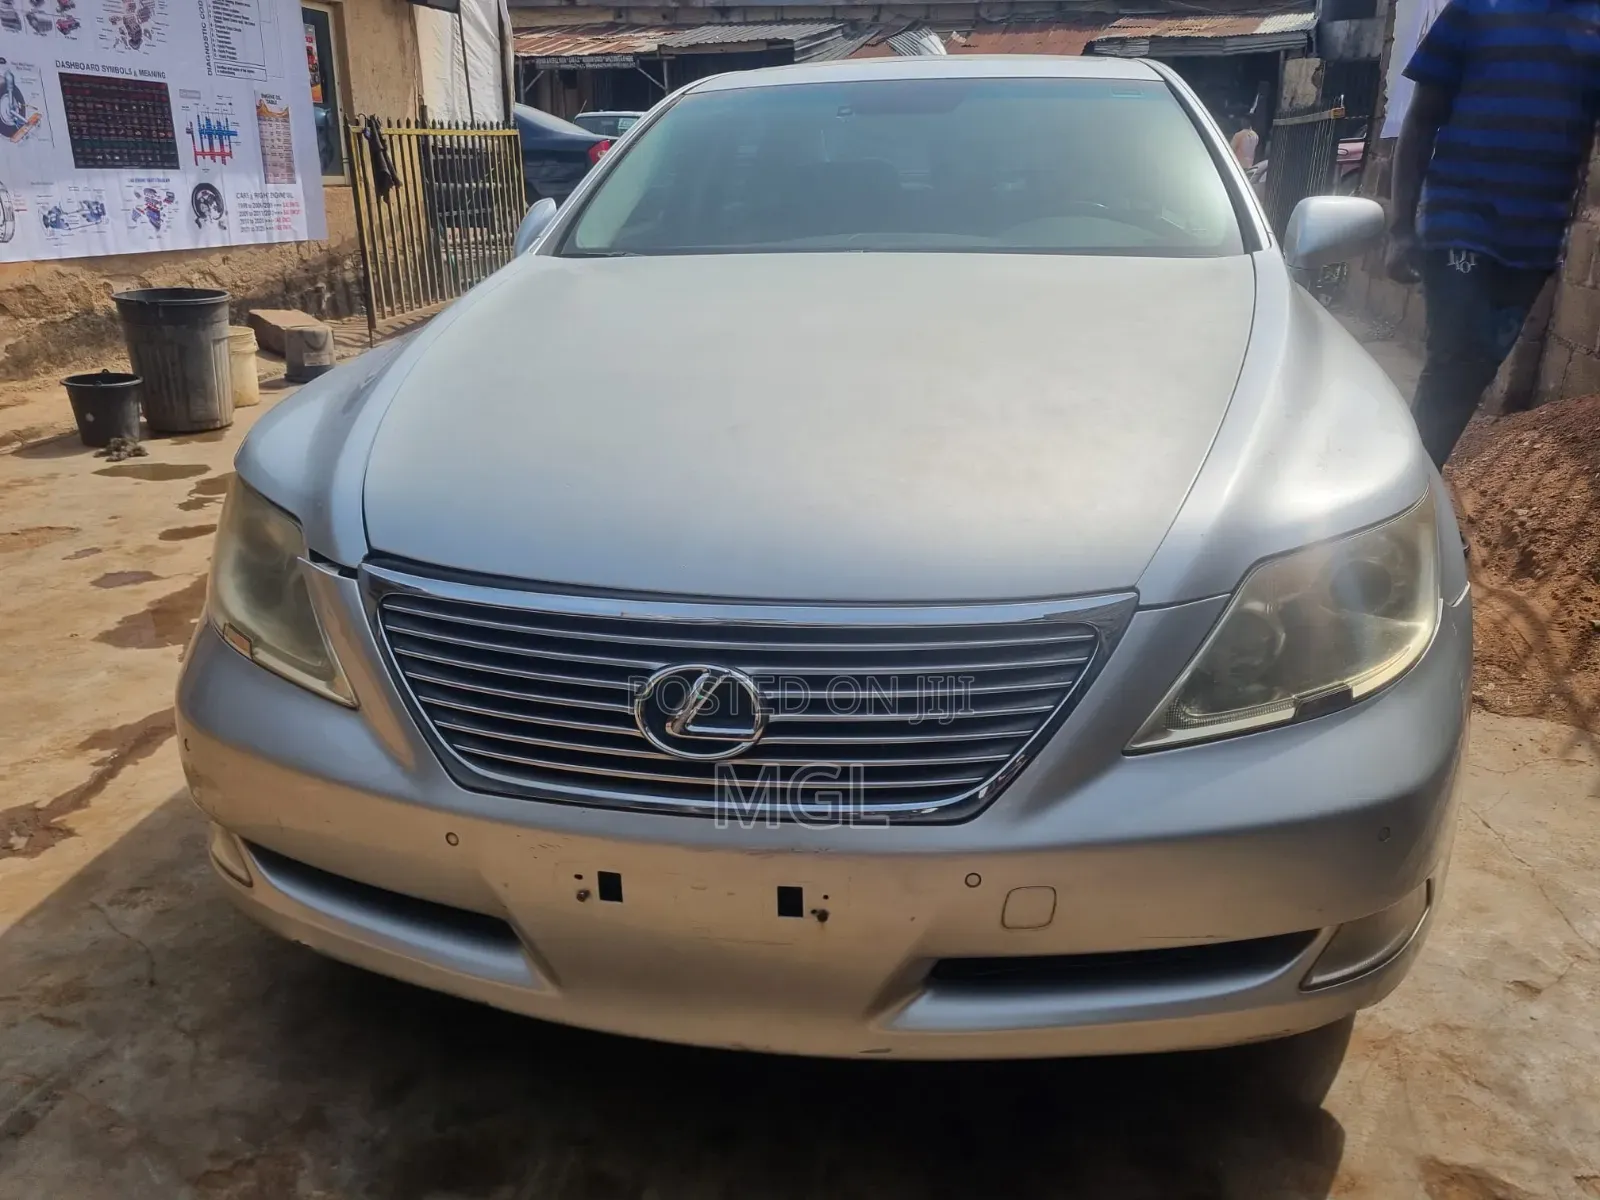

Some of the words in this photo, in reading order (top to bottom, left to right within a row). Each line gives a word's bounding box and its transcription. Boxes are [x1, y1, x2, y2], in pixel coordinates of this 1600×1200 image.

[201, 22, 213, 76] DIAGNOSTIC
[55, 59, 100, 72] DASHBOARD
[101, 64, 133, 75] SYMBOLS
[138, 69, 166, 79] MEANING
